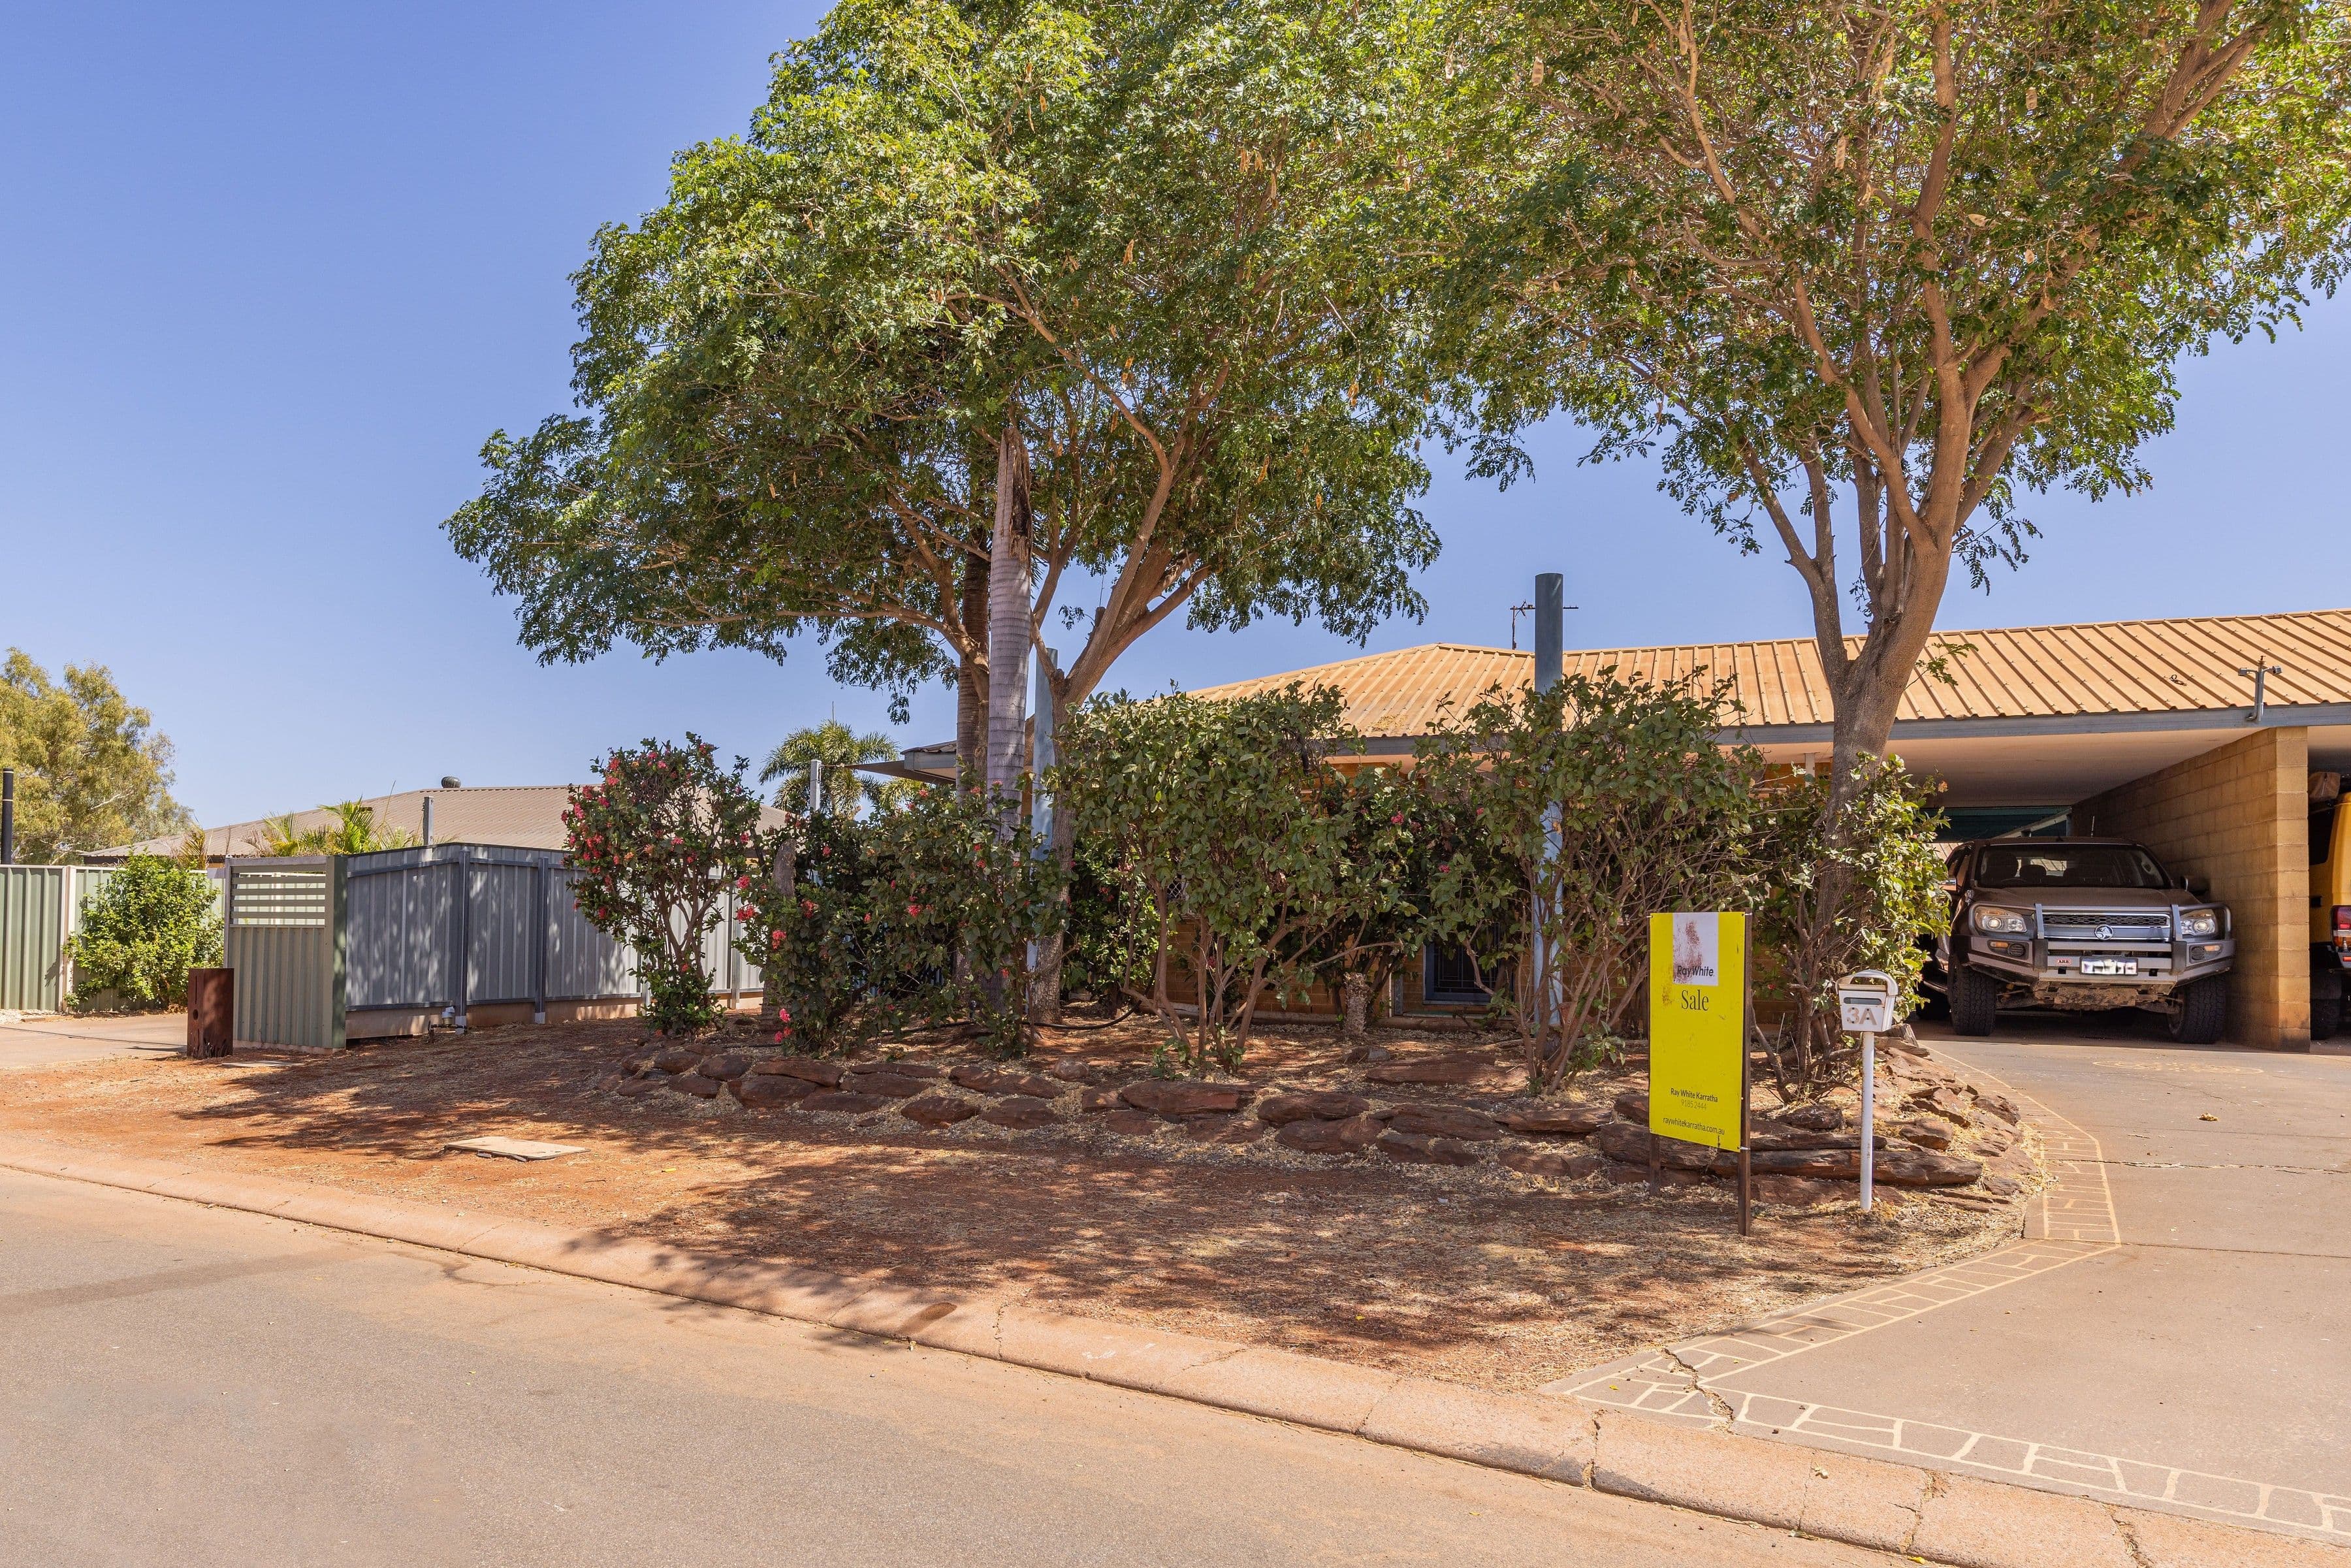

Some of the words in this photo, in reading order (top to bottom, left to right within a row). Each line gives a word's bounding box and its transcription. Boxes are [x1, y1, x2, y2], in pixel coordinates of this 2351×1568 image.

[1681, 989, 1709, 1011] Sale
[1846, 1007, 1877, 1025] 3A
[1671, 1087, 1680, 1097] Ray
[1680, 1089, 1695, 1098] White
[1696, 1091, 1718, 1103] Karratha
[1681, 1099, 1693, 1108] 9185
[1694, 1101, 1707, 1110] 2444
[1663, 1117, 1725, 1135] raywhitekarratha.com.au
